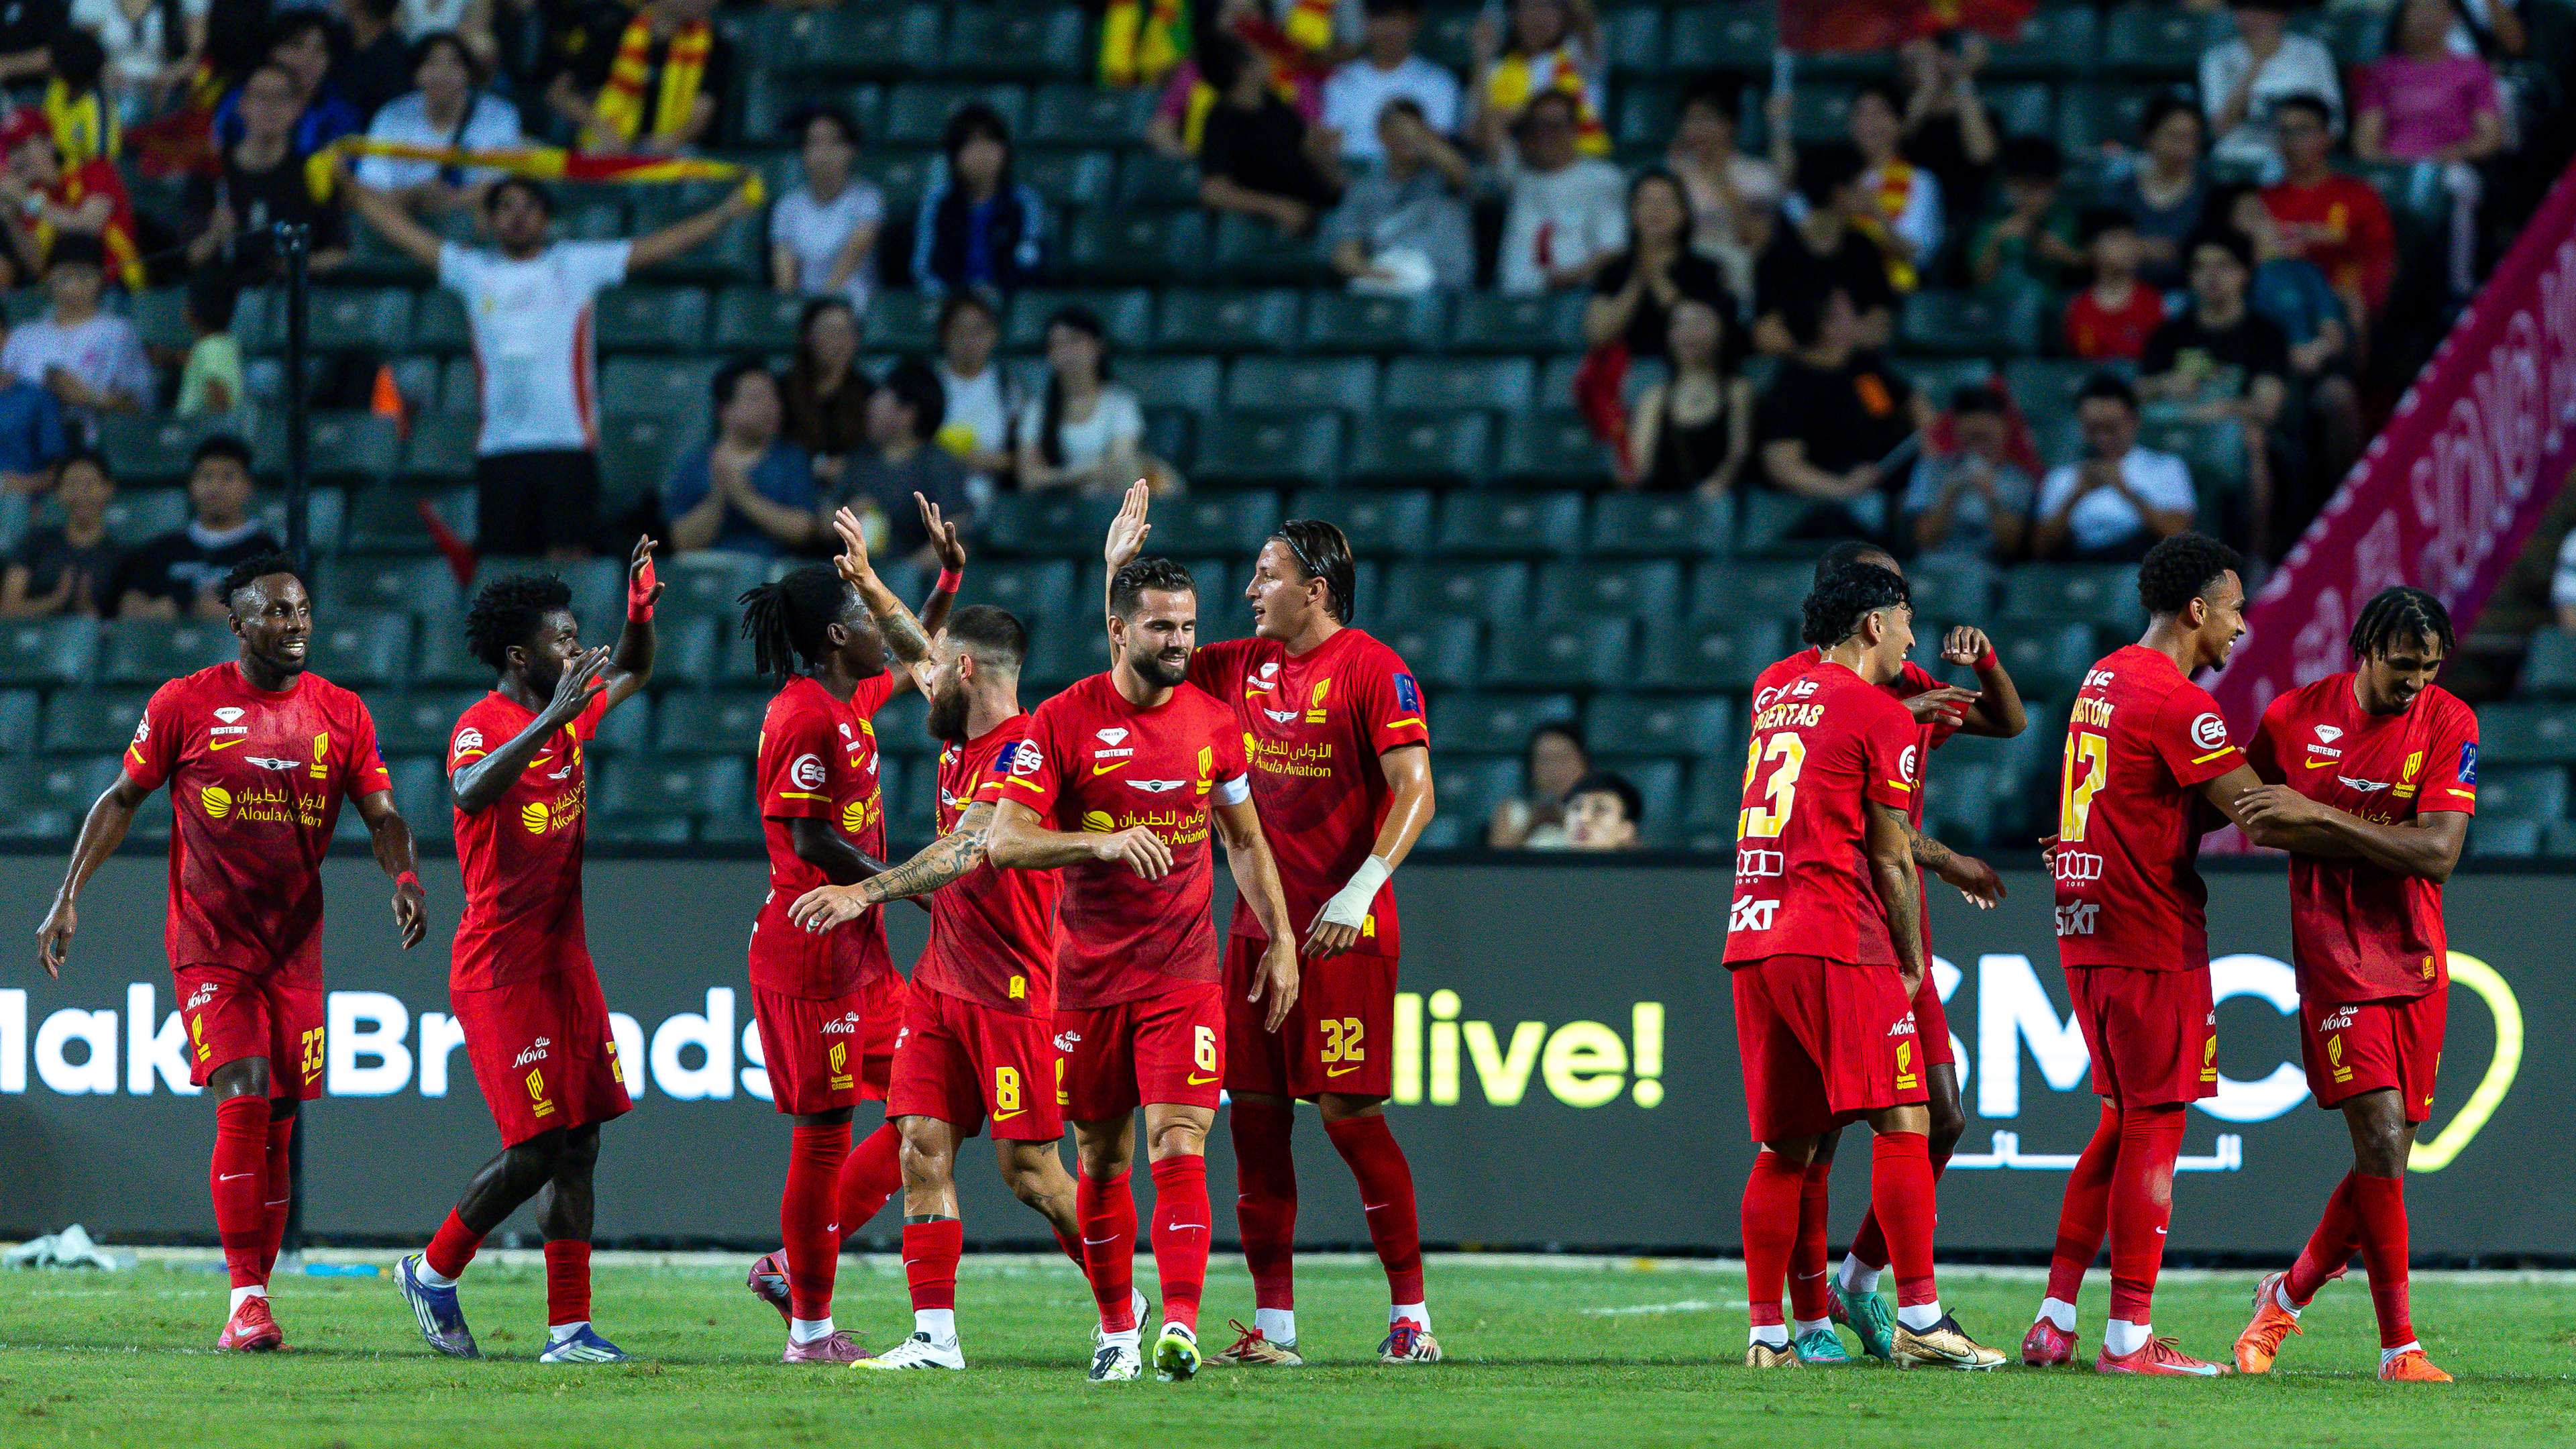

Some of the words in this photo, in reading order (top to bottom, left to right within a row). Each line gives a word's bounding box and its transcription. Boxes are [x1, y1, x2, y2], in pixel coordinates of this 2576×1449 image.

[1289, 741, 1332, 761] الأولى
[2306, 743, 2343, 758] BESTEBIT
[800, 763, 826, 783] SG
[1283, 761, 1331, 777] Aviation
[236, 786, 288, 806] للطيران
[2059, 731, 2108, 843] 17
[235, 806, 282, 822] Aloula
[1729, 894, 1780, 932] IXT
[185, 990, 212, 1012] Nova
[819, 1018, 856, 1034] Nova
[1887, 1018, 1916, 1036] Nova
[2318, 1012, 2353, 1032] Nova
[302, 1026, 325, 1074] 33
[1193, 1024, 1216, 1073] 6
[1320, 1017, 1365, 1063] 32
[512, 1046, 548, 1069] Nova
[996, 1065, 1020, 1110] 8
